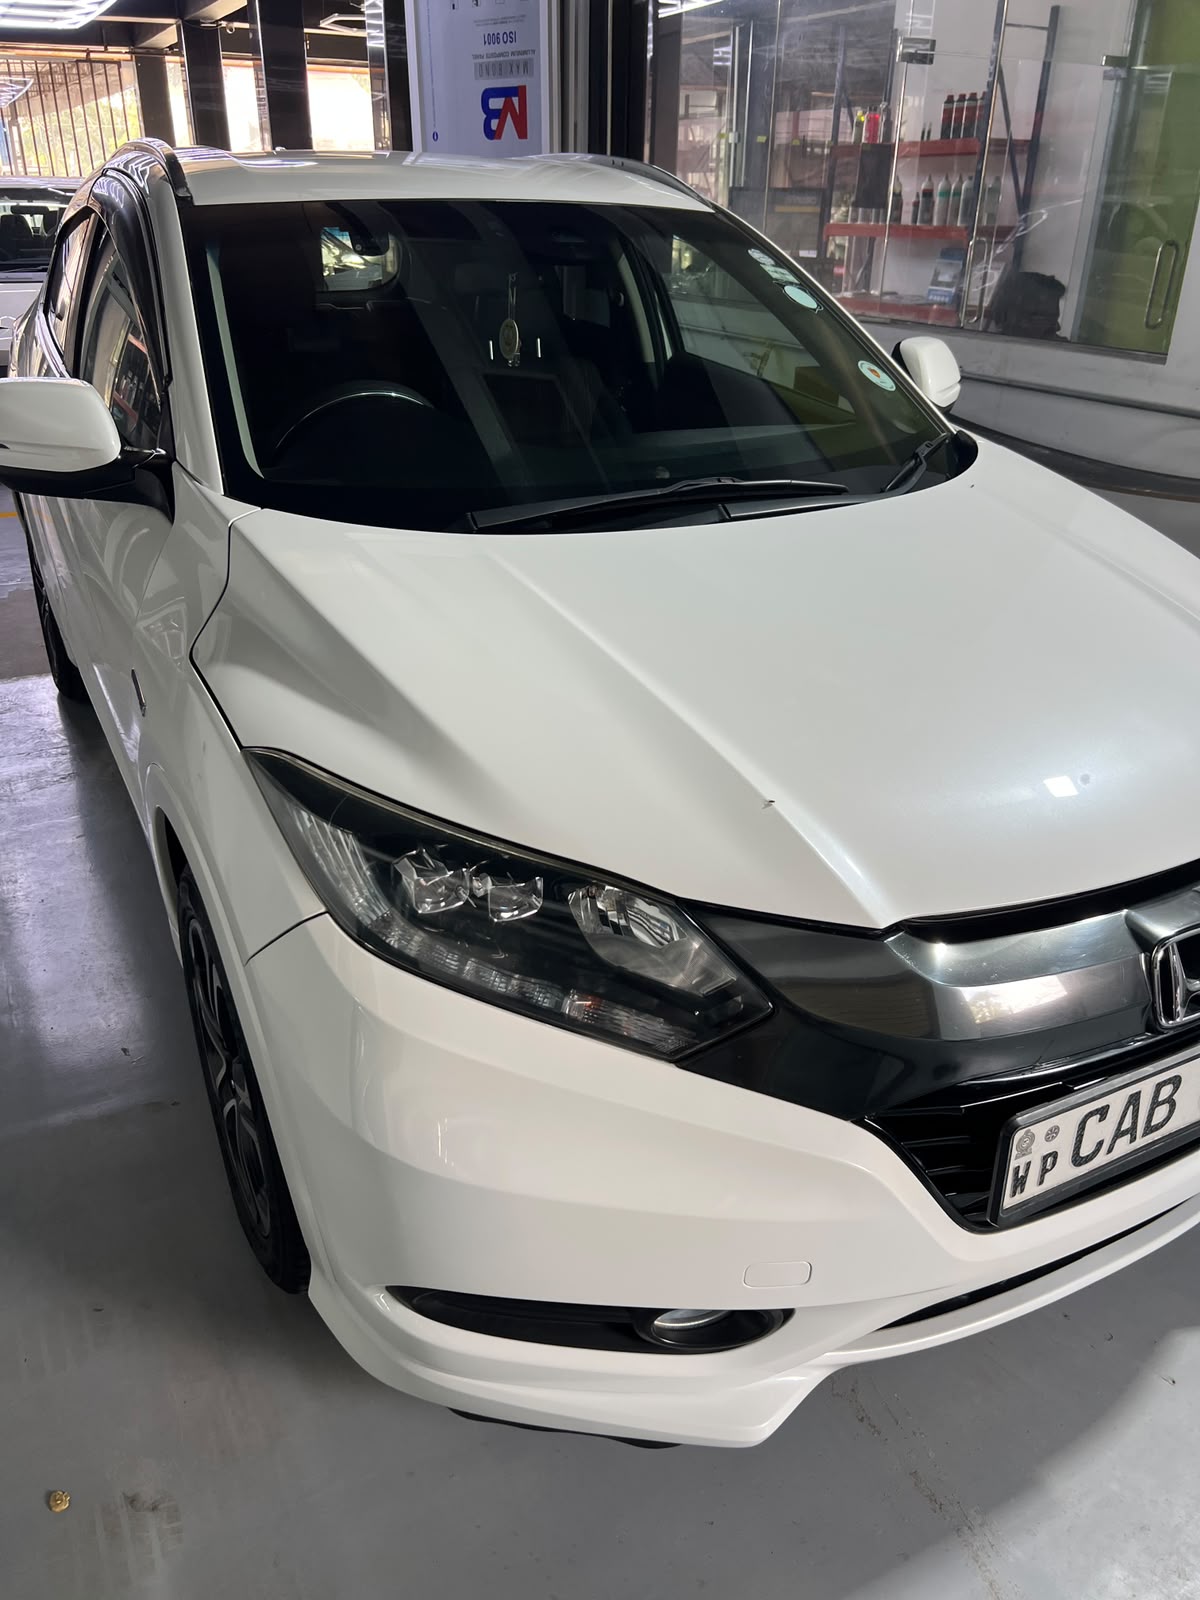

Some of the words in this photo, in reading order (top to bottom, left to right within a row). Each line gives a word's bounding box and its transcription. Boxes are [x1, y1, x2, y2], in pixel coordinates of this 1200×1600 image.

[483, 32, 501, 46] 9001
[502, 31, 517, 44] ISO
[479, 62, 503, 78] BOND
[509, 60, 529, 75] MAX
[481, 85, 528, 141] MB
[1071, 1074, 1182, 1168] CAB
